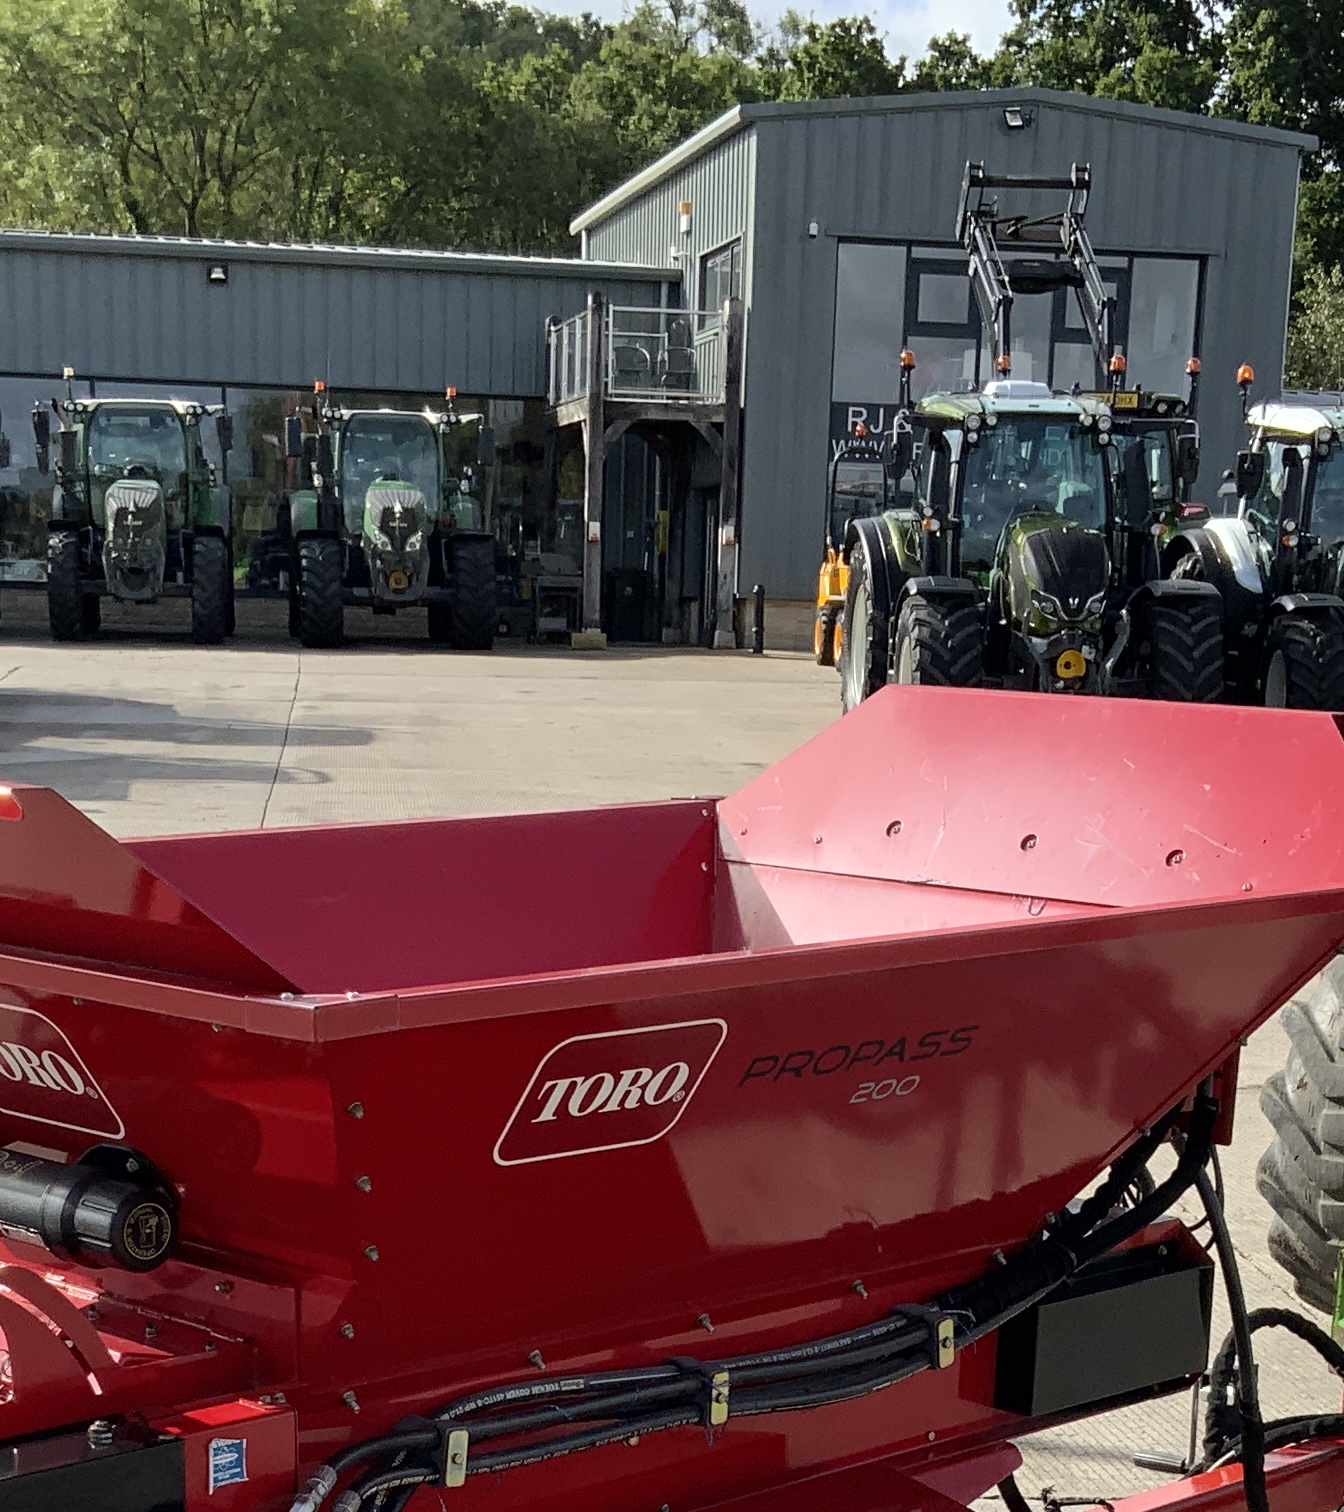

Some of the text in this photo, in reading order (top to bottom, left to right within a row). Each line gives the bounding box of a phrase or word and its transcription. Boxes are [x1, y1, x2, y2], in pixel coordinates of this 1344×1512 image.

[848, 407, 884, 434] RJ
[738, 1025, 979, 1088] PROPASS
[531, 1061, 690, 1123] TORO
[849, 1075, 921, 1104] 200
